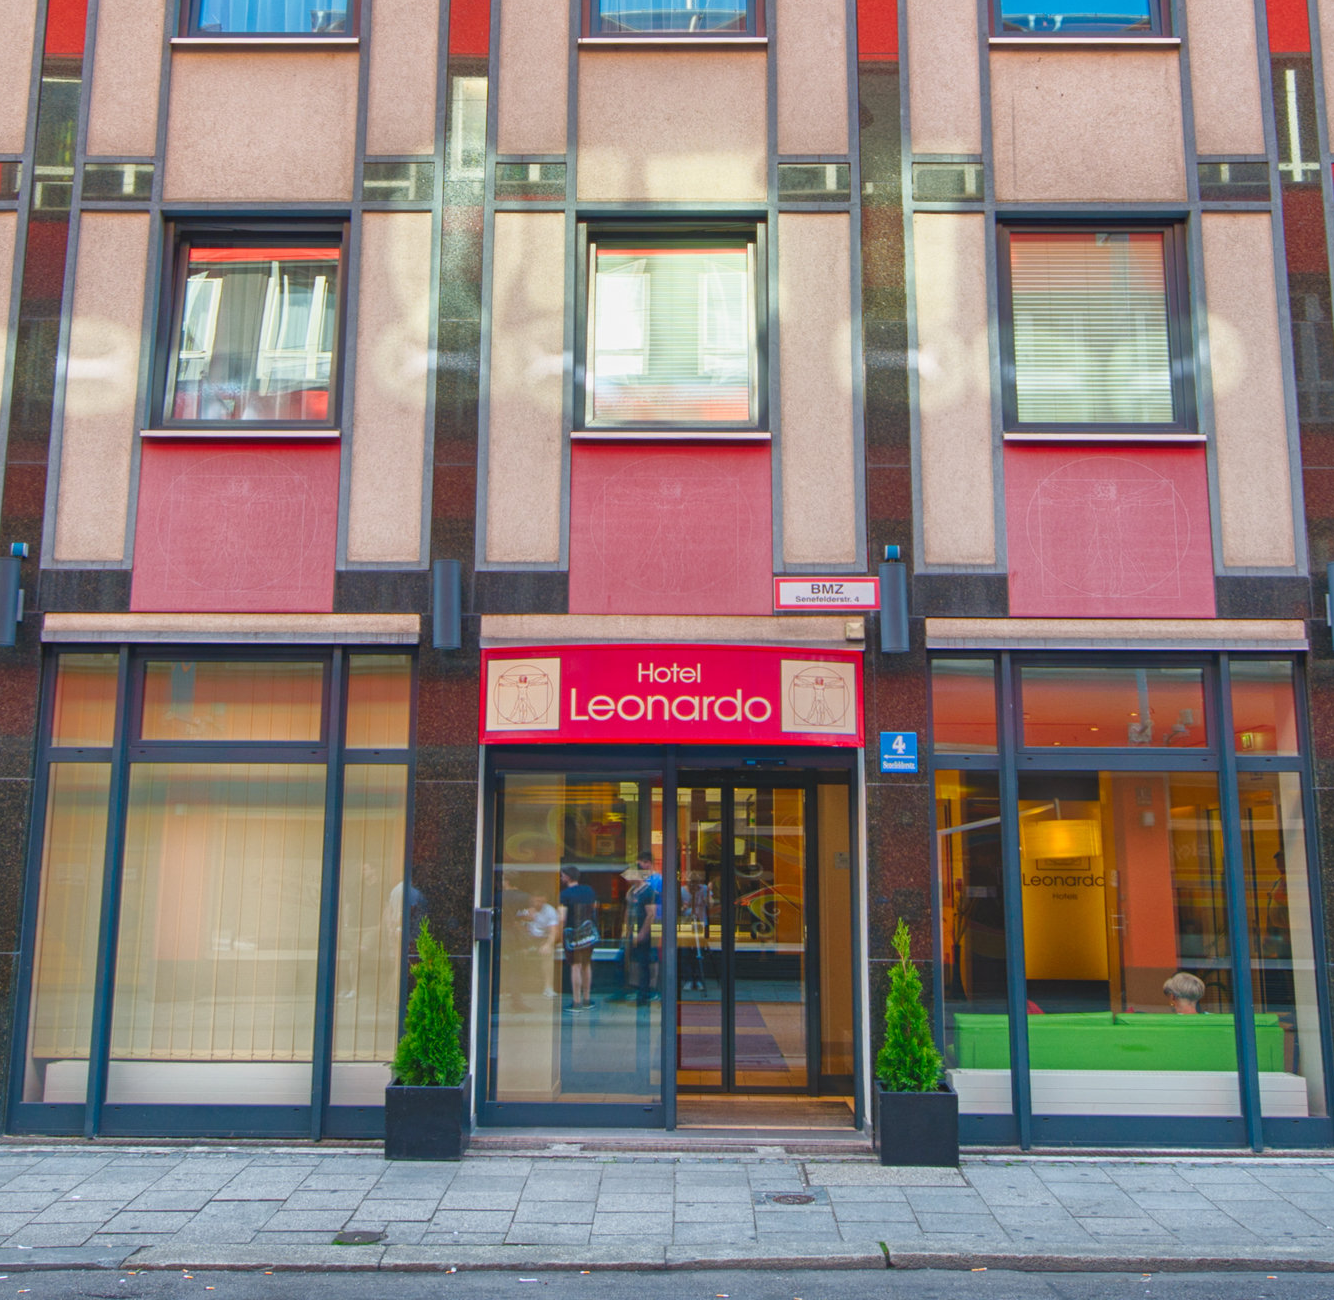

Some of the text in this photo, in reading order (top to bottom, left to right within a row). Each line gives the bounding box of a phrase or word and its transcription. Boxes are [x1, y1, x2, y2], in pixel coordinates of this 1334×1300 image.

[810, 583, 844, 595] BMZ
[795, 595, 860, 603] Senefelderstr. 4
[637, 663, 702, 685] Hotel
[569, 688, 773, 723] Leonardo
[892, 735, 906, 754] 4
[1022, 872, 1105, 887] Leonardo
